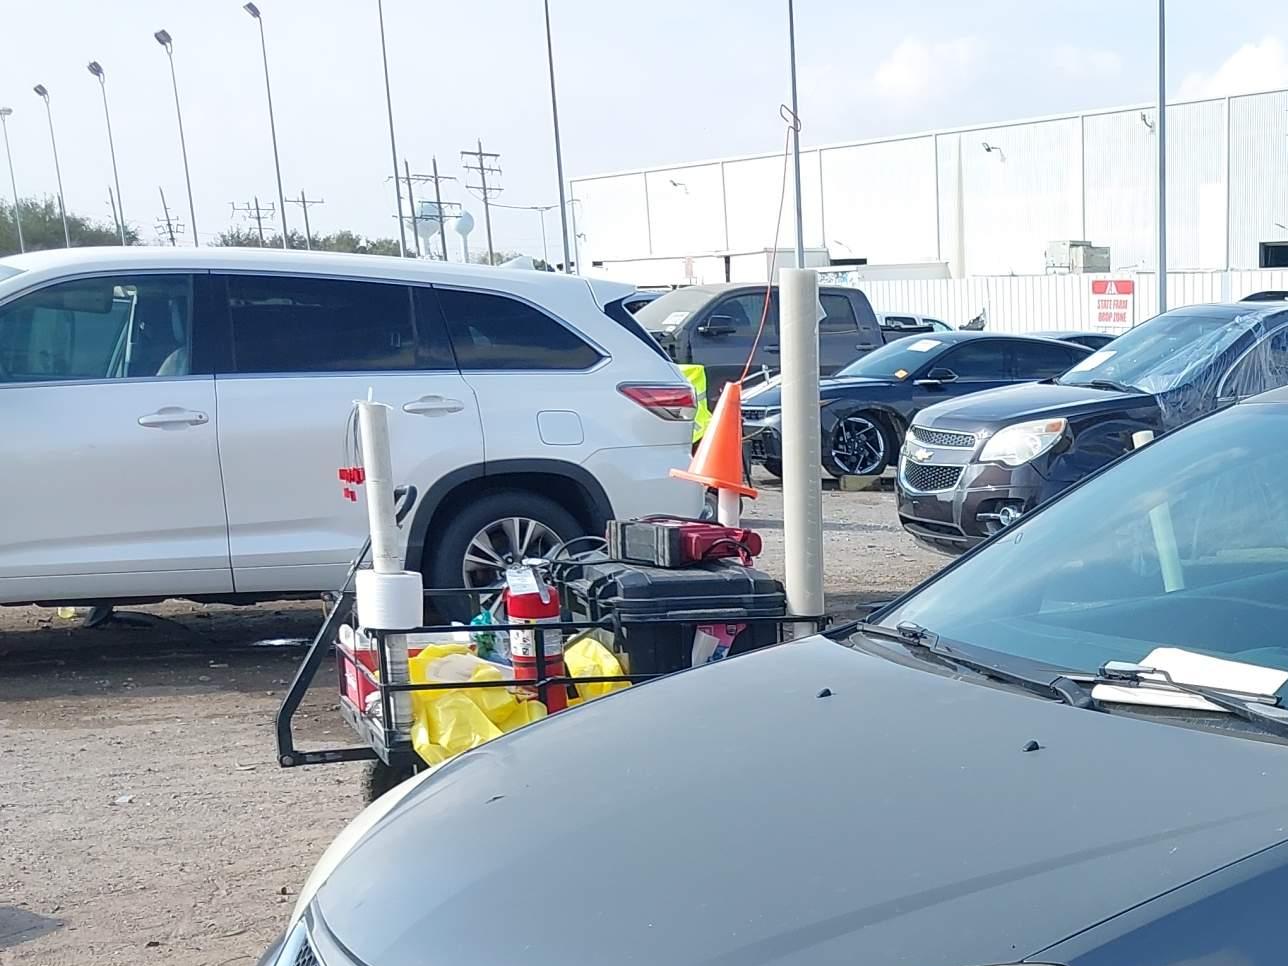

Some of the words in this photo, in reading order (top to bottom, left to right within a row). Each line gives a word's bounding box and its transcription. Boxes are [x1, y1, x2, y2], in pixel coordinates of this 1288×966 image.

[1097, 299, 1112, 310] STATE
[1113, 299, 1128, 310] FARM
[1098, 312, 1112, 322] DROP
[1113, 312, 1127, 322] ZONE
